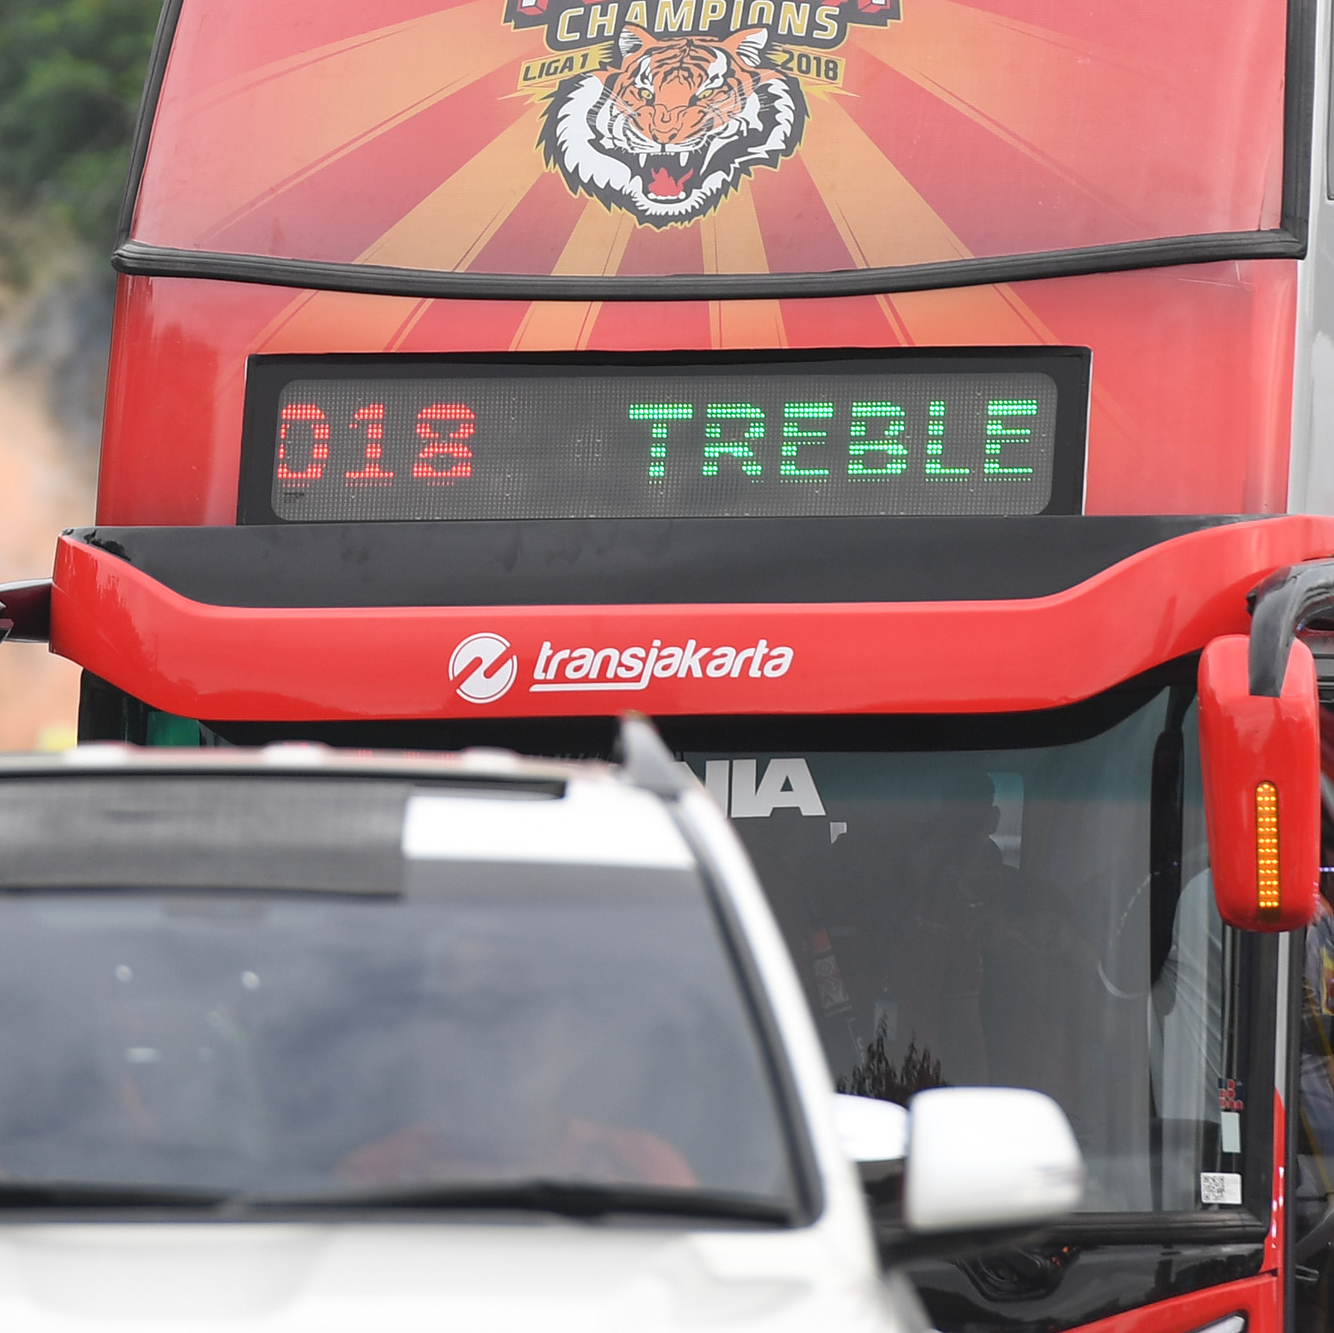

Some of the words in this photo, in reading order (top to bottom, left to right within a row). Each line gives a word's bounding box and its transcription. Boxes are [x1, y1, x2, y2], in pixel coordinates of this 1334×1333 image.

[522, 56, 575, 82] LIGA
[579, 52, 590, 70] 1
[780, 48, 839, 82] 2018
[628, 398, 1039, 481] TREBLE
[530, 638, 795, 692] transjakarta
[680, 757, 827, 819] NIA
